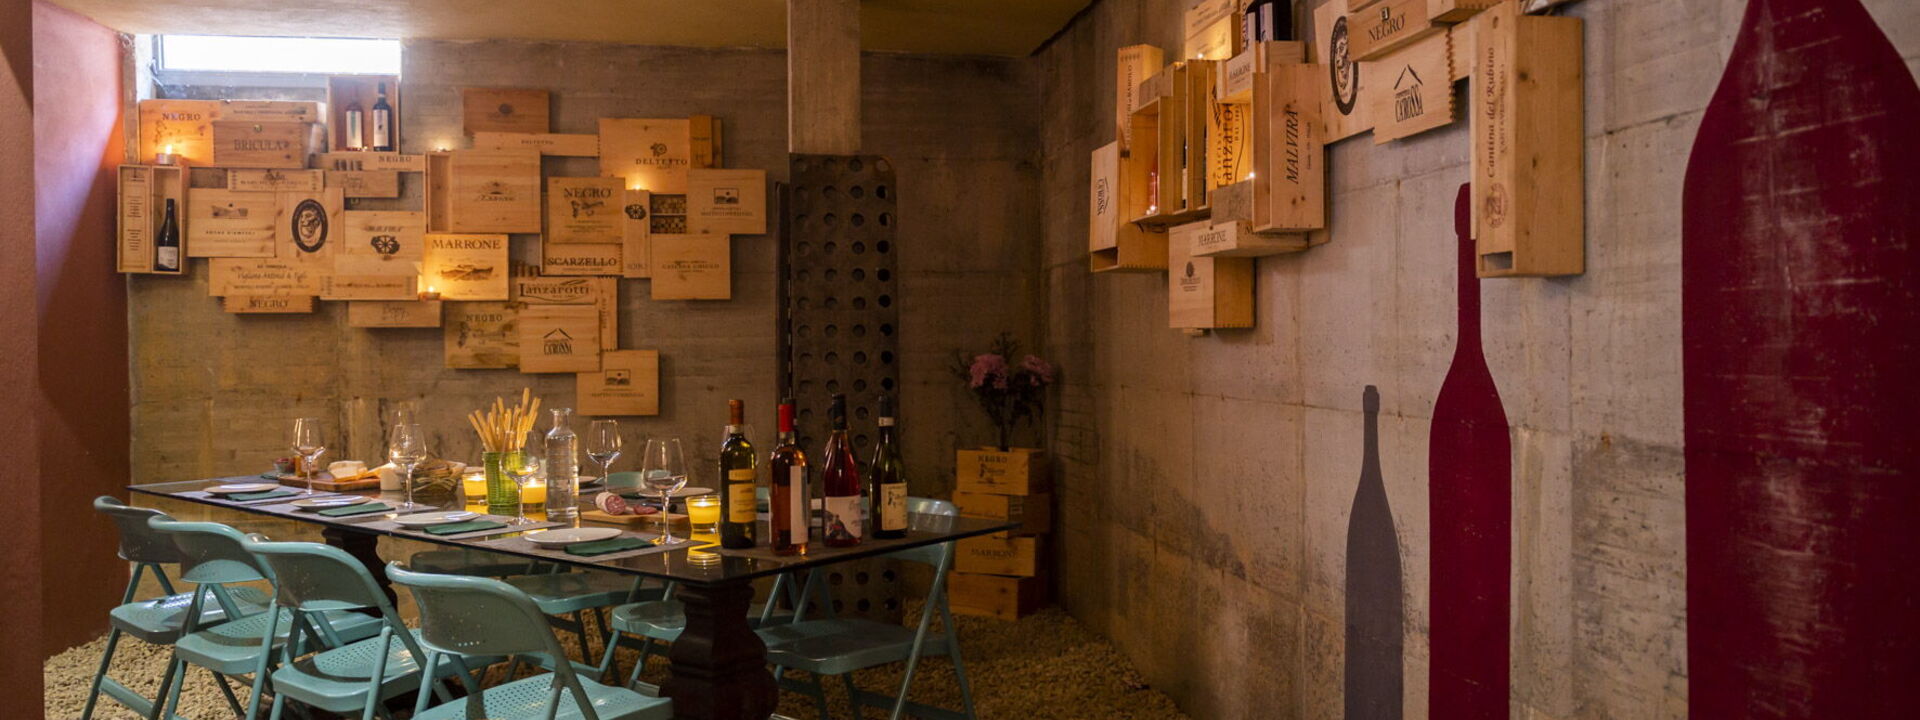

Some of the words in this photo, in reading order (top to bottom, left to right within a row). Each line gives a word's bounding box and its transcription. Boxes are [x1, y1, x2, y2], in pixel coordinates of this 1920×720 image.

[1368, 14, 1405, 43] NEGRO
[1486, 47, 1496, 97] Rubino
[162, 112, 201, 121] NEGRO
[1485, 101, 1496, 120] del
[1486, 125, 1496, 178] Cantina
[378, 155, 412, 163] NEGRO
[563, 187, 612, 199] NEGRO
[431, 238, 502, 250] MARRONE
[546, 257, 617, 266] SCARZELLO
[519, 281, 590, 297] Lanzarotti
[466, 313, 503, 323] NEGRO
